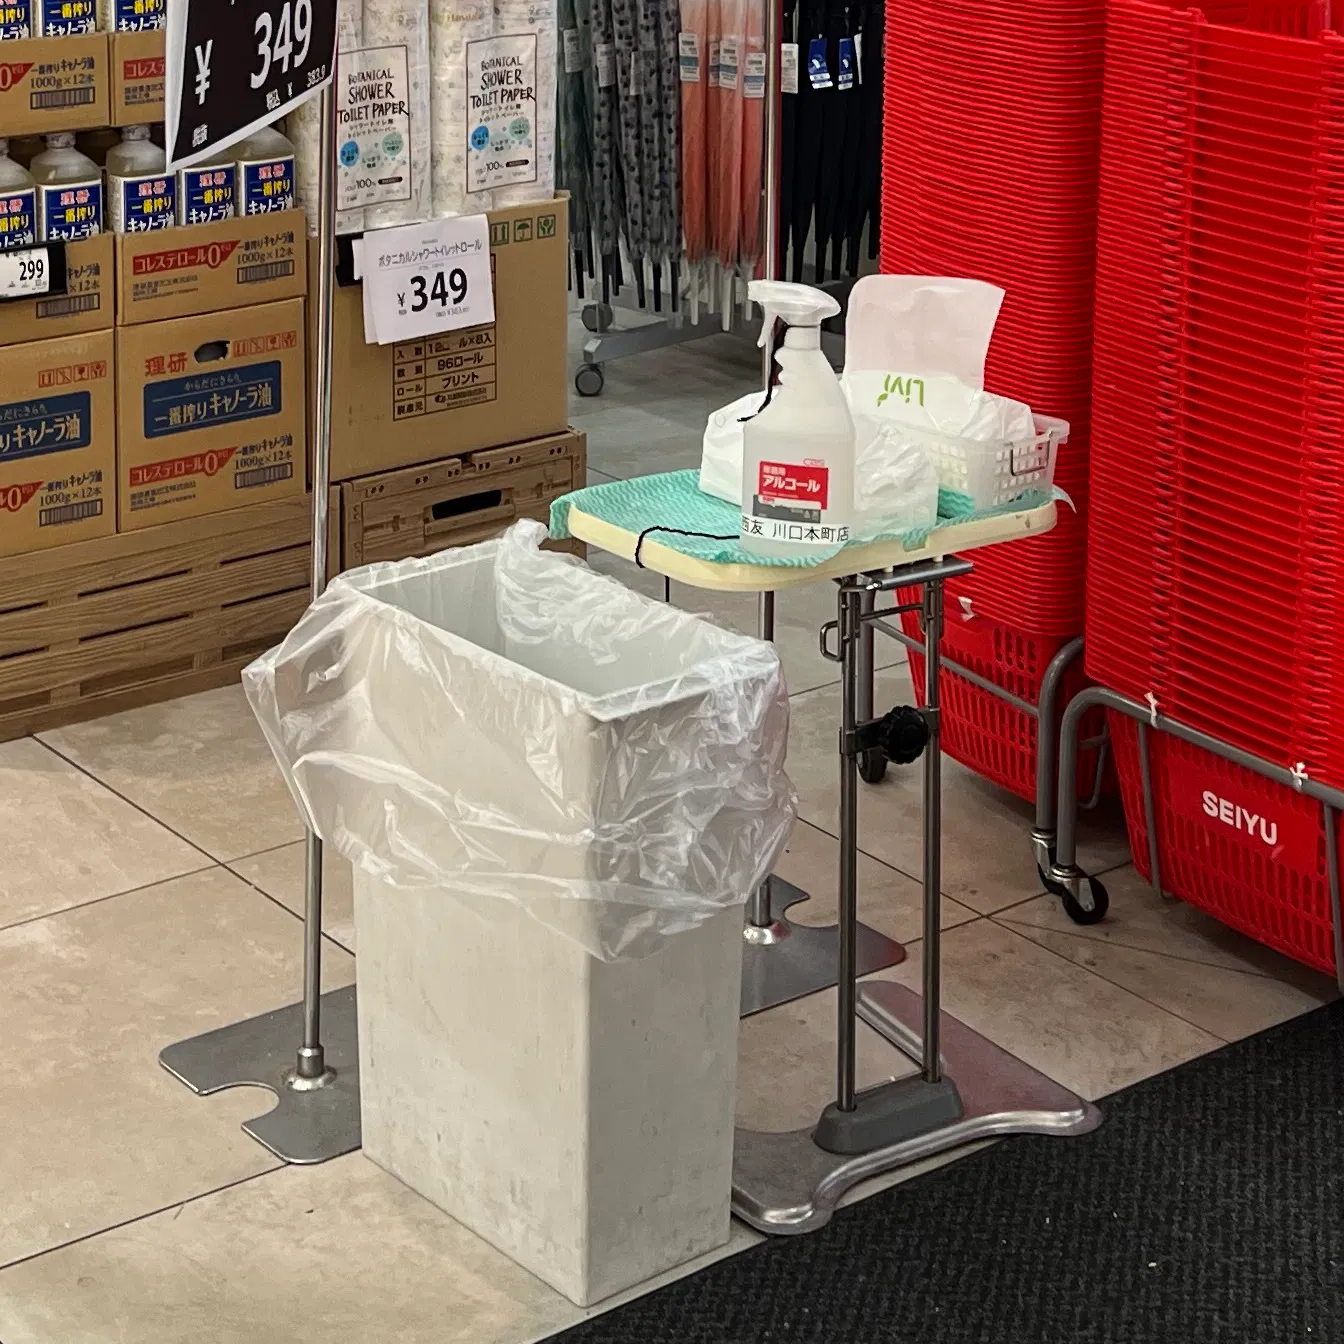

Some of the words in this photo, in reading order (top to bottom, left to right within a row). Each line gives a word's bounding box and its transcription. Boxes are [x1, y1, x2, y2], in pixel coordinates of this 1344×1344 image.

[50, 1, 92, 18] 一番搾り
[481, 55, 523, 72] BOTANICAL
[30, 73, 95, 90] 1000g×12本
[348, 67, 394, 85] BOTANICAL
[481, 69, 523, 91] SHOWER
[348, 81, 395, 105] SHOWER
[470, 89, 498, 110] TOILET
[338, 104, 369, 125] TOILET
[372, 100, 409, 118] PAPER
[378, 239, 483, 268] ボタニカルシャワートイレットロール
[19, 259, 43, 282] 299
[410, 267, 468, 313] 349
[145, 351, 188, 376] 理研
[437, 351, 484, 371] 96ロール
[397, 383, 423, 396] ロール
[442, 372, 479, 388] プリント
[878, 374, 924, 407] Livi
[154, 382, 272, 426] 一番搾りキャノーラ油
[762, 474, 821, 493] アルコール
[40, 485, 102, 506] 1000g×12本
[773, 523, 849, 543] 川口本町店
[1202, 790, 1277, 845] SEIYU
